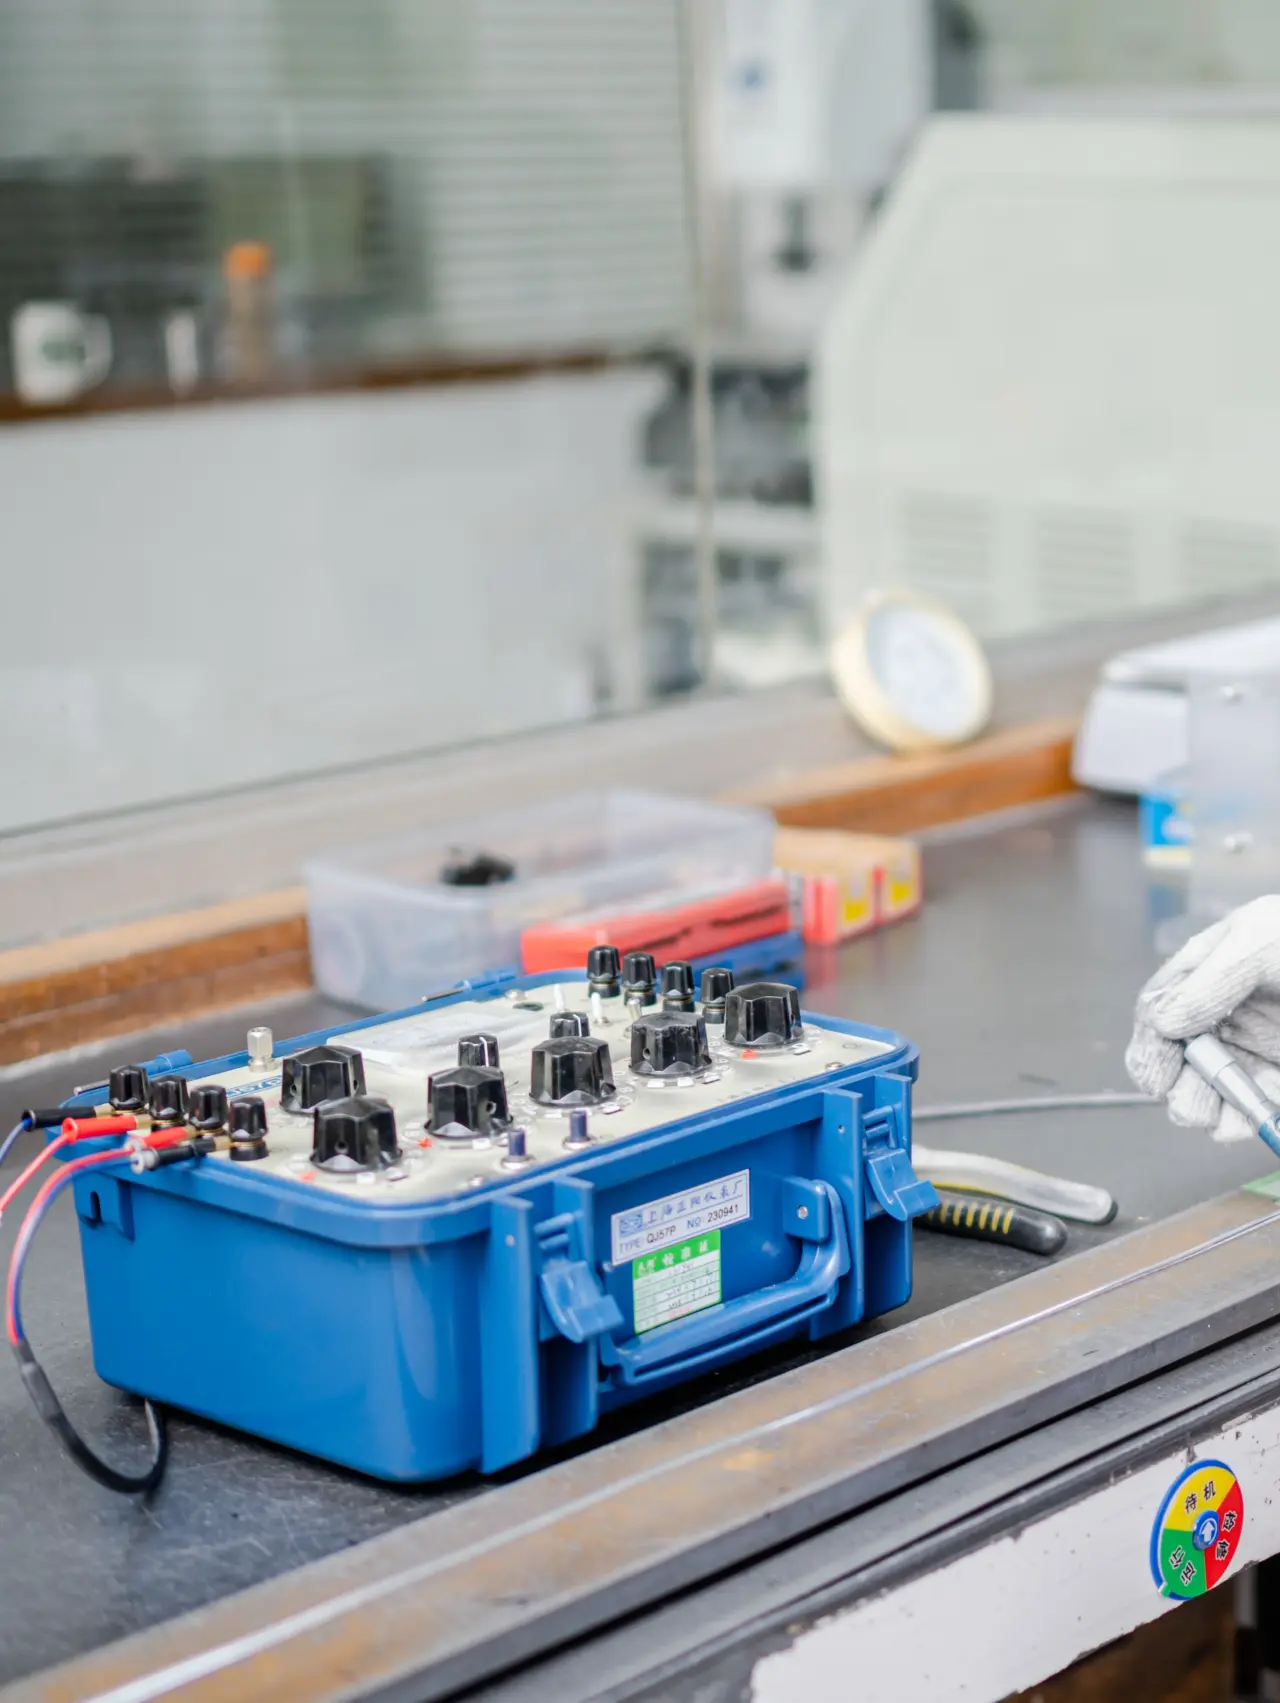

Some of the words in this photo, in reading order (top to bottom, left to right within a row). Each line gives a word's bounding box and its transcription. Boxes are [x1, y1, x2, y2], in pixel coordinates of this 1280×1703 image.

[646, 1225, 677, 1245] QJ57P
[707, 1204, 739, 1223] 230941
[1185, 1481, 1216, 1513] 待机
[1216, 1511, 1237, 1560] 检修
[1169, 1545, 1196, 1586] 运行
